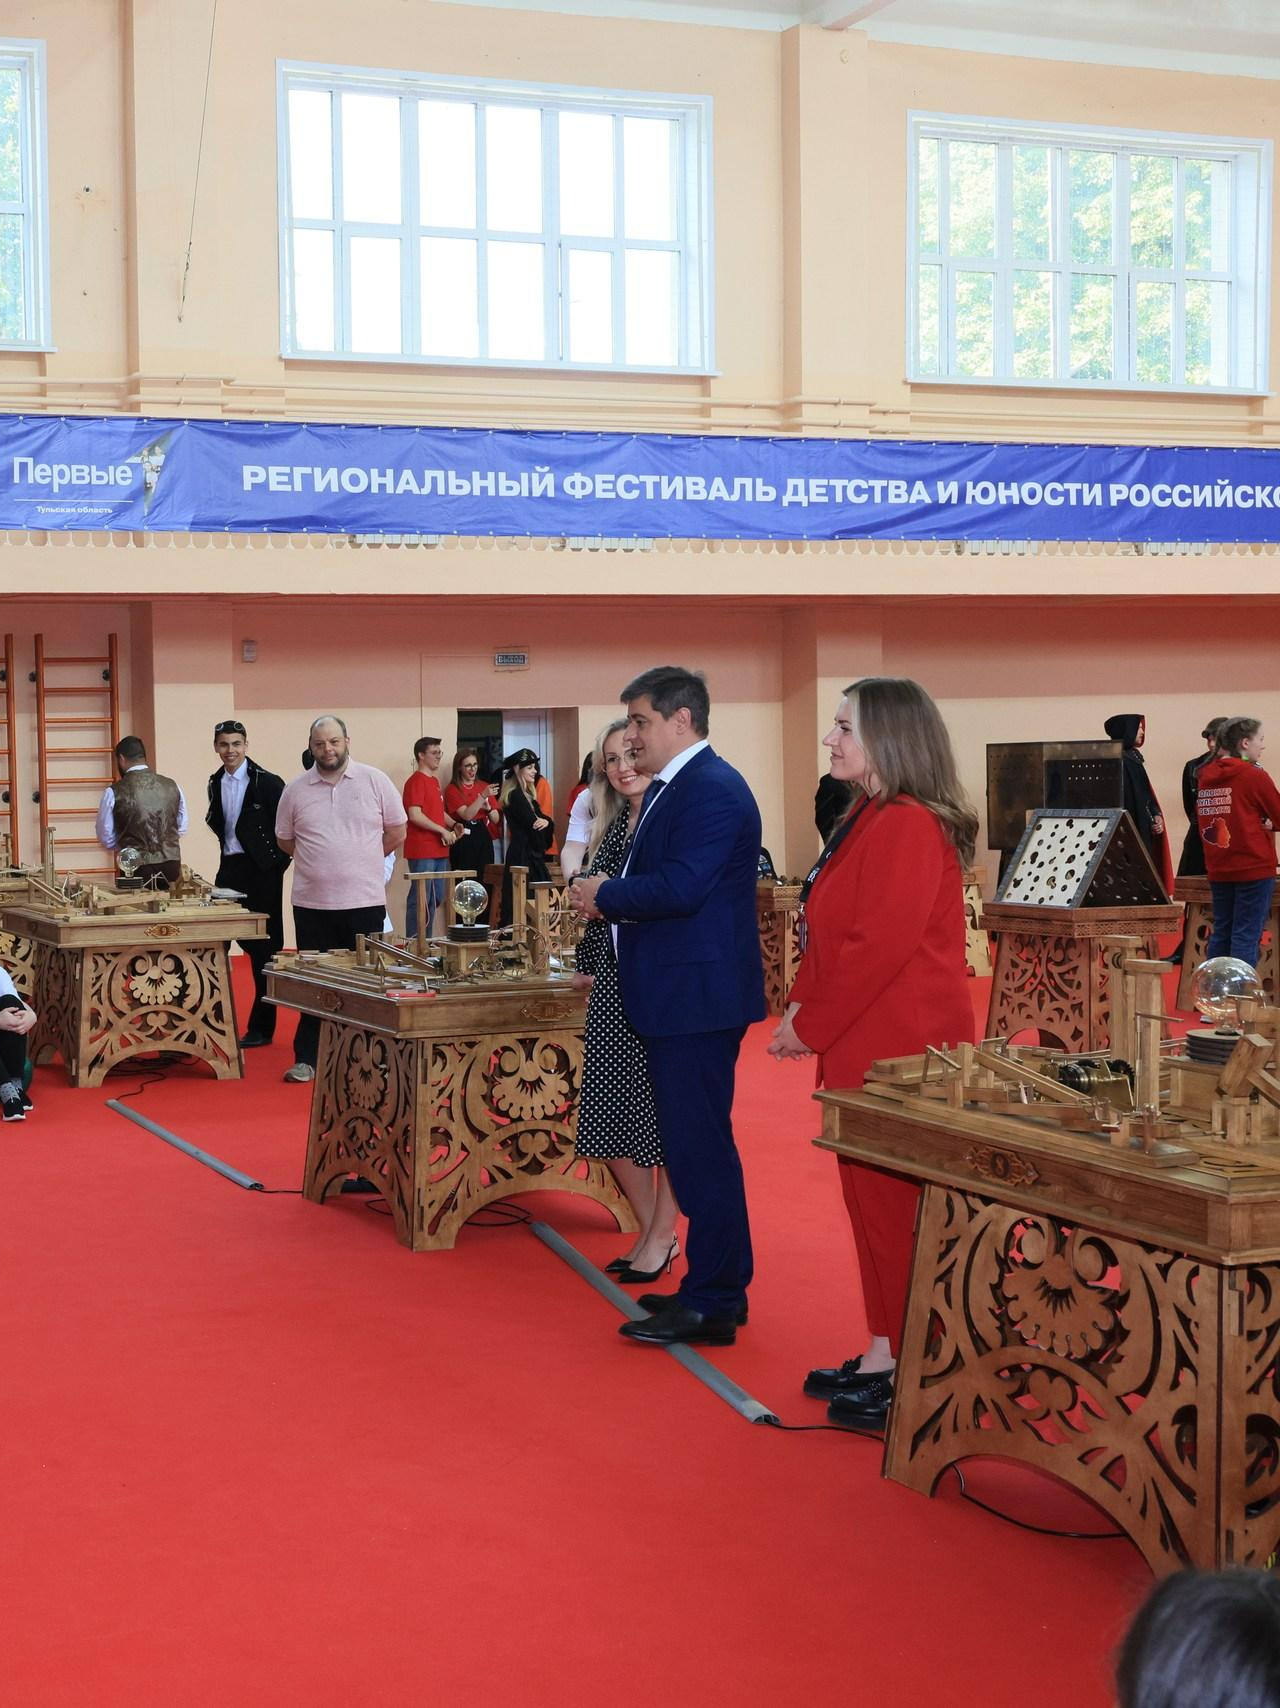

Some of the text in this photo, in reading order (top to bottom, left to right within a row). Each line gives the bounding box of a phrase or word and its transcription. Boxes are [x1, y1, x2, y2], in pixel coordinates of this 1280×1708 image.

[13, 456, 133, 493] Первые
[242, 465, 555, 497] РЕГИОНАЛЬНЫЙ
[563, 472, 777, 501] ФЕСТИВАЛЬ
[782, 478, 931, 507] ДЕТСТВА
[937, 480, 959, 502] И
[965, 480, 1102, 506] ЮНОСТИ
[36, 506, 113, 514] Тульская область
